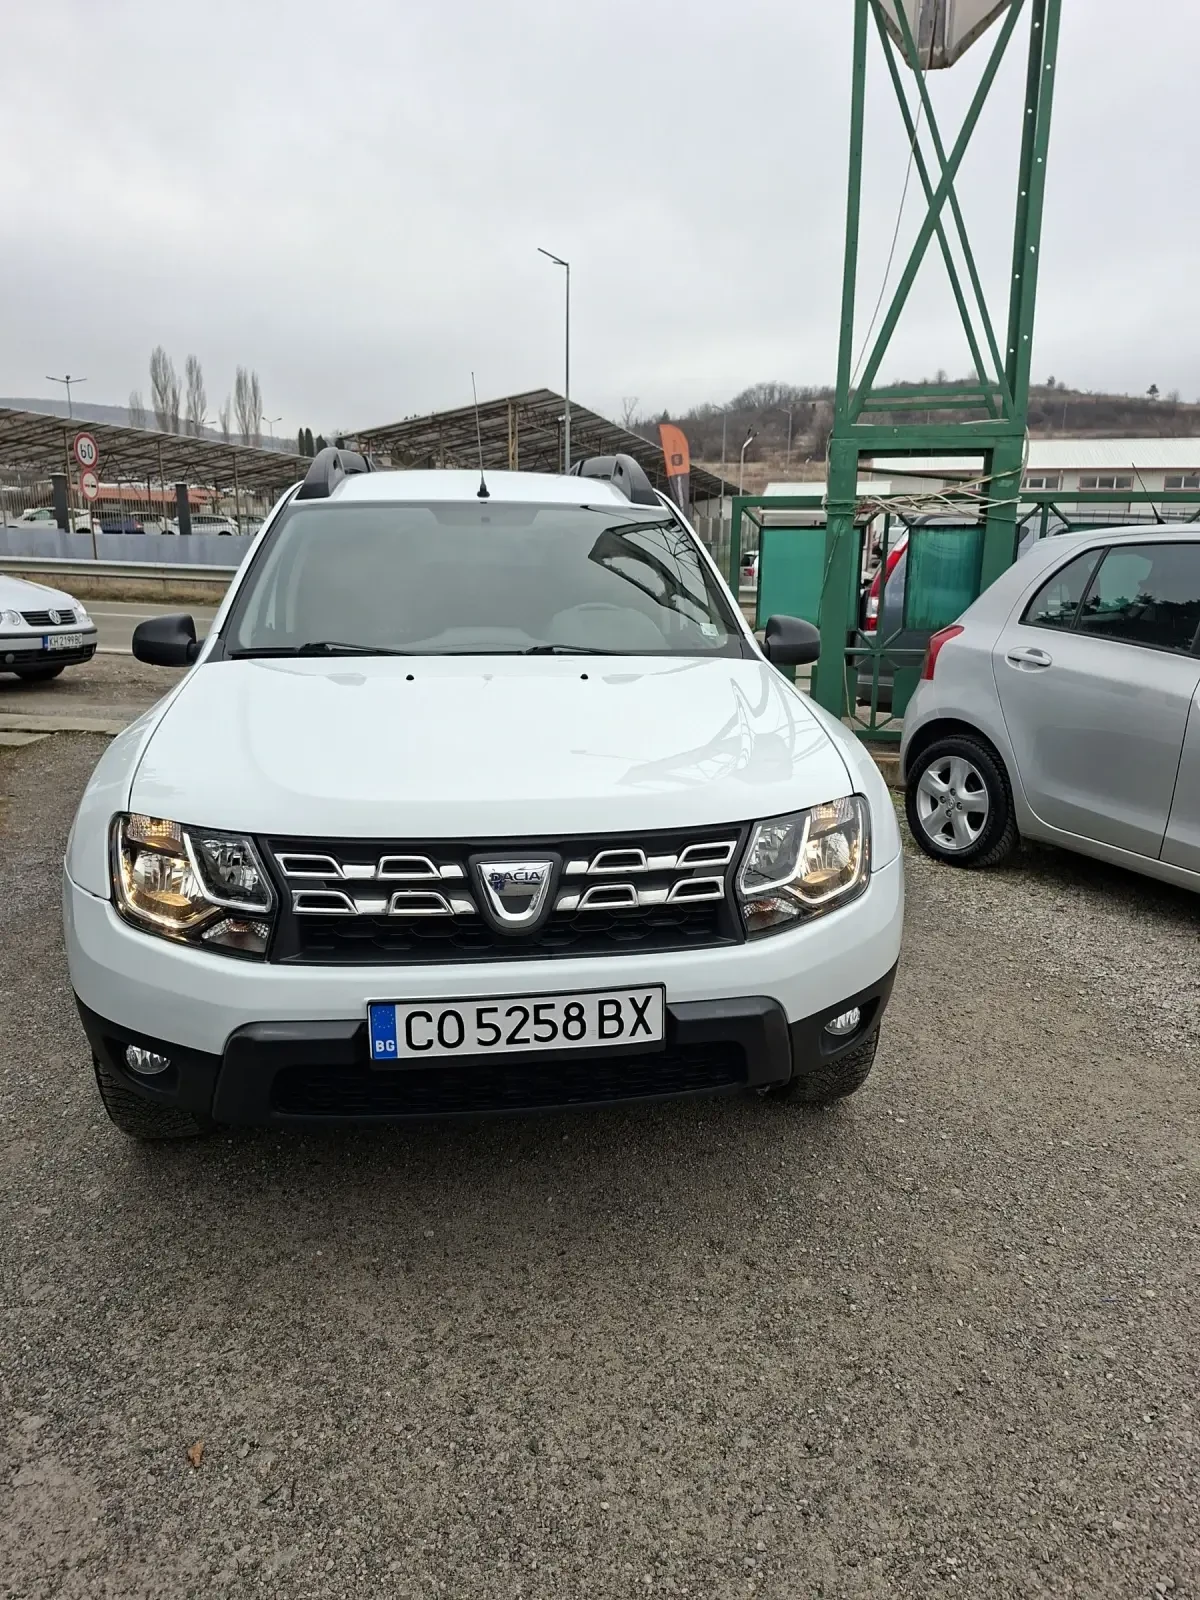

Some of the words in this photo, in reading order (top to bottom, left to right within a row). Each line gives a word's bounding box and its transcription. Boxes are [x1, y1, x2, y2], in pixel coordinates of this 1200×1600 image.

[80, 443, 94, 459] 60
[490, 871, 540, 881] DACIA
[405, 1009, 465, 1051] CO
[476, 1001, 587, 1047] 5258
[598, 995, 653, 1040] BX
[375, 1039, 395, 1052] BG
